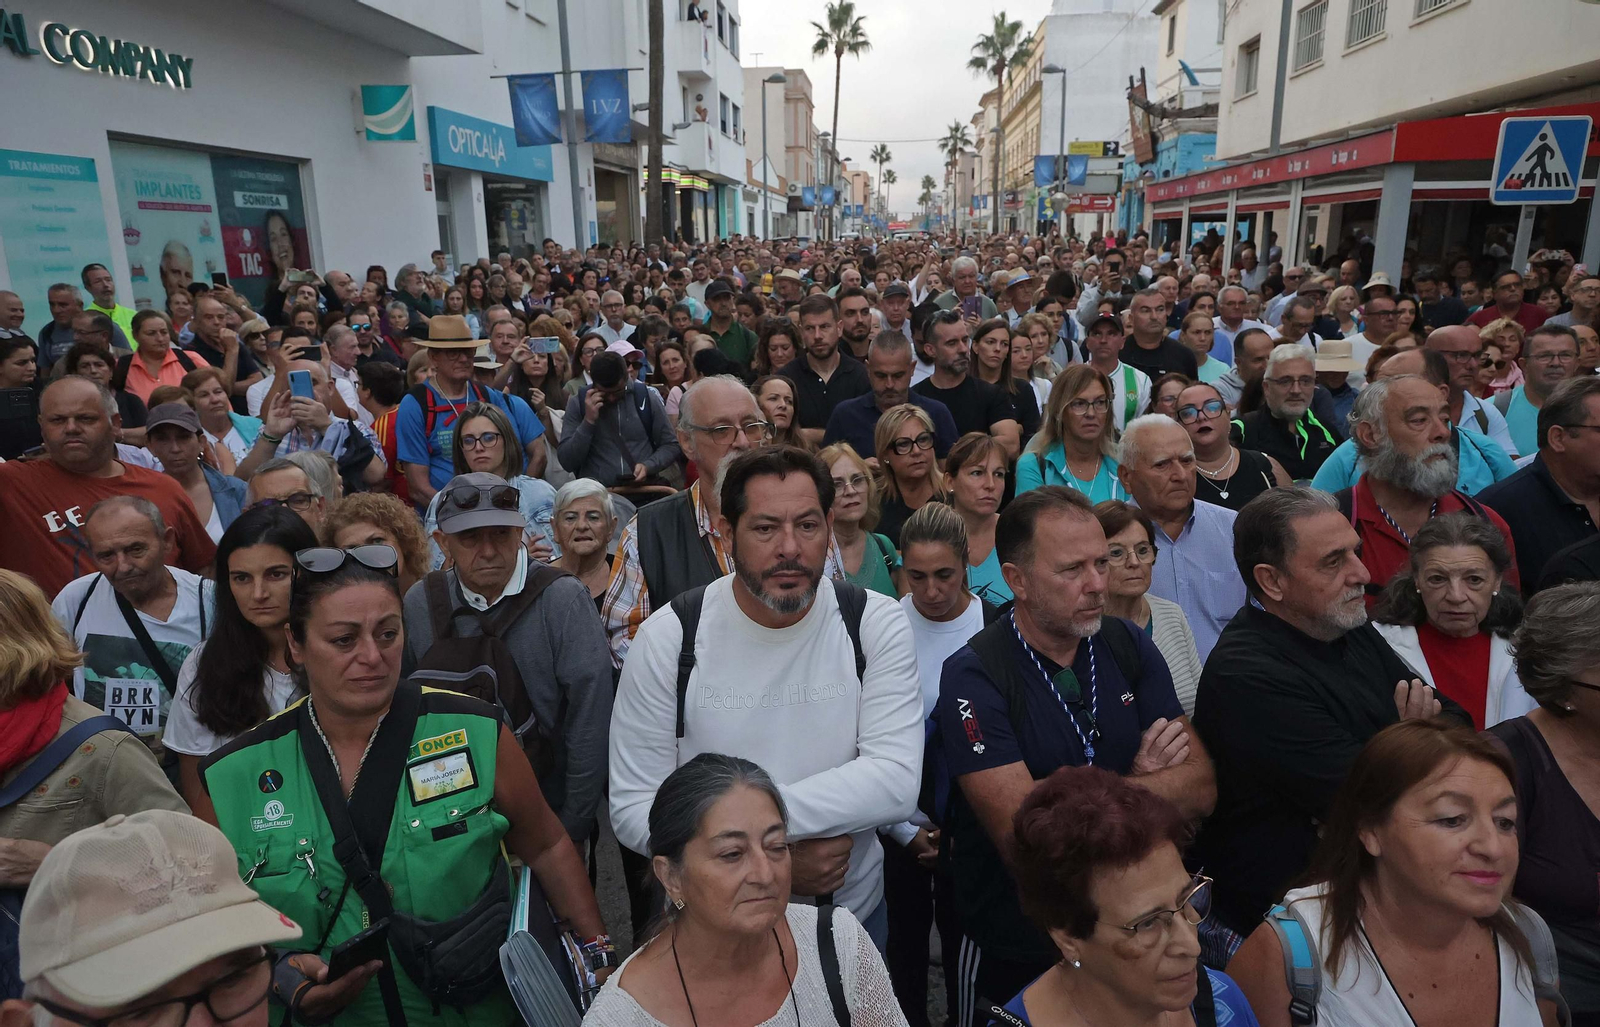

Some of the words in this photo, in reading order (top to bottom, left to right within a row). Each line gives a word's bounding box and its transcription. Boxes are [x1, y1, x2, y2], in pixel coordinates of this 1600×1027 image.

[41, 22, 194, 89] COMPANY
[592, 98, 622, 115] LVZ
[8, 160, 80, 175] TRATAMIENTOS
[135, 180, 202, 200] IMPLANTES
[242, 194, 282, 207] SONRISA
[239, 252, 263, 276] TAC
[112, 687, 153, 705] BRK
[699, 686, 755, 710] Pedro
[760, 685, 785, 708] del
[787, 681, 848, 706] Hierro
[422, 733, 463, 753] ONCE
[442, 767, 464, 779] JOSEFA
